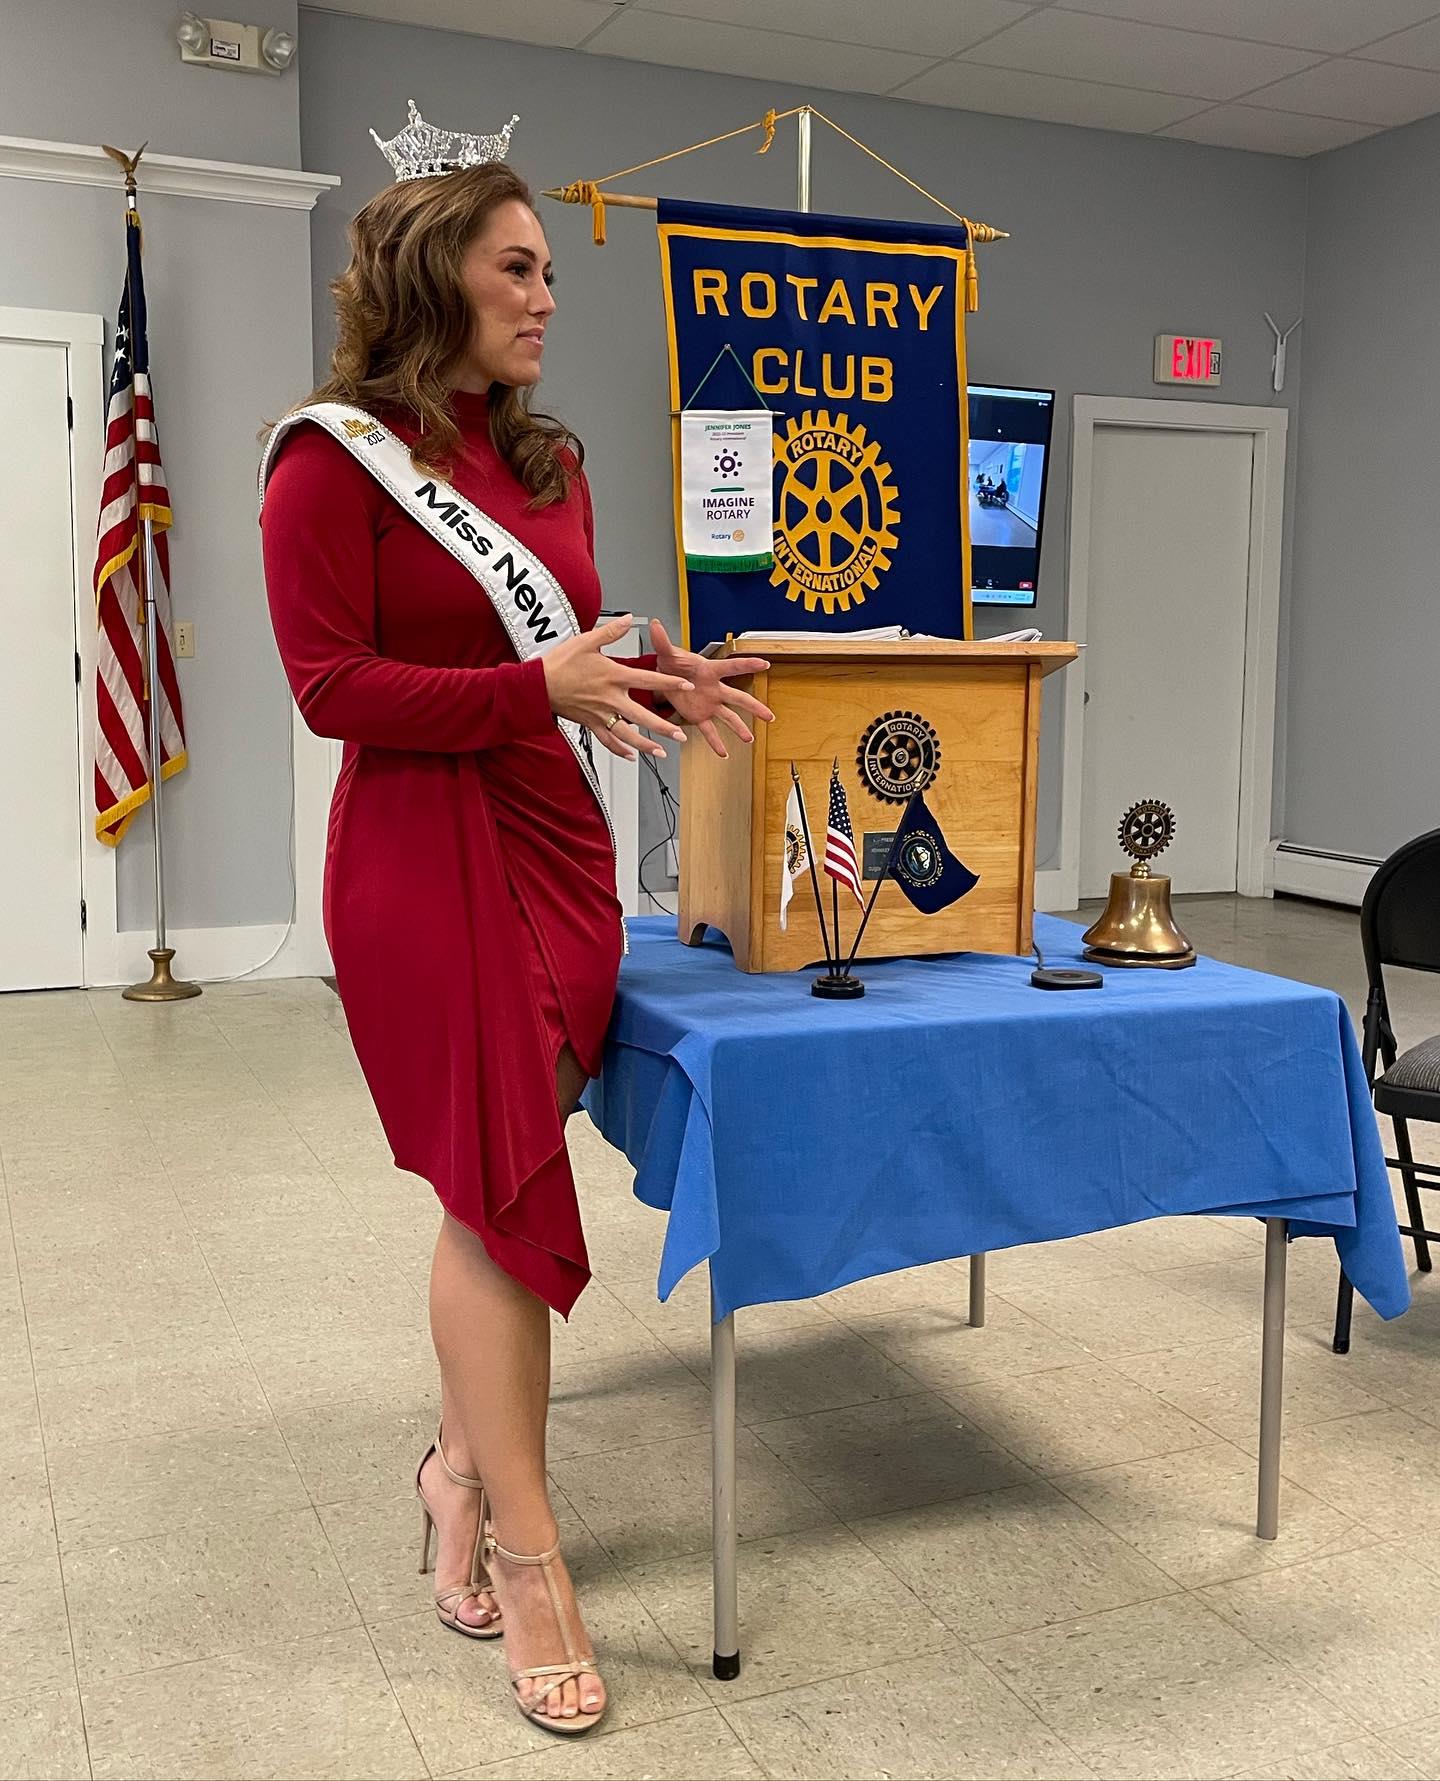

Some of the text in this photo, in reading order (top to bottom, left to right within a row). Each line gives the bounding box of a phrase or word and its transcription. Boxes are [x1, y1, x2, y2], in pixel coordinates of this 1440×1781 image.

[693, 268, 943, 331] ROTARY
[753, 347, 893, 402] CLUB
[1172, 338, 1215, 381] EXIT
[363, 431, 385, 446] 2023
[791, 432, 863, 463] ROTARY
[702, 497, 755, 508] IMAGINE
[707, 509, 751, 520] ROTARY
[415, 481, 558, 644] Miss New
[773, 536, 877, 592] INTERNATIONAL
[889, 722, 925, 738] ROTARY
